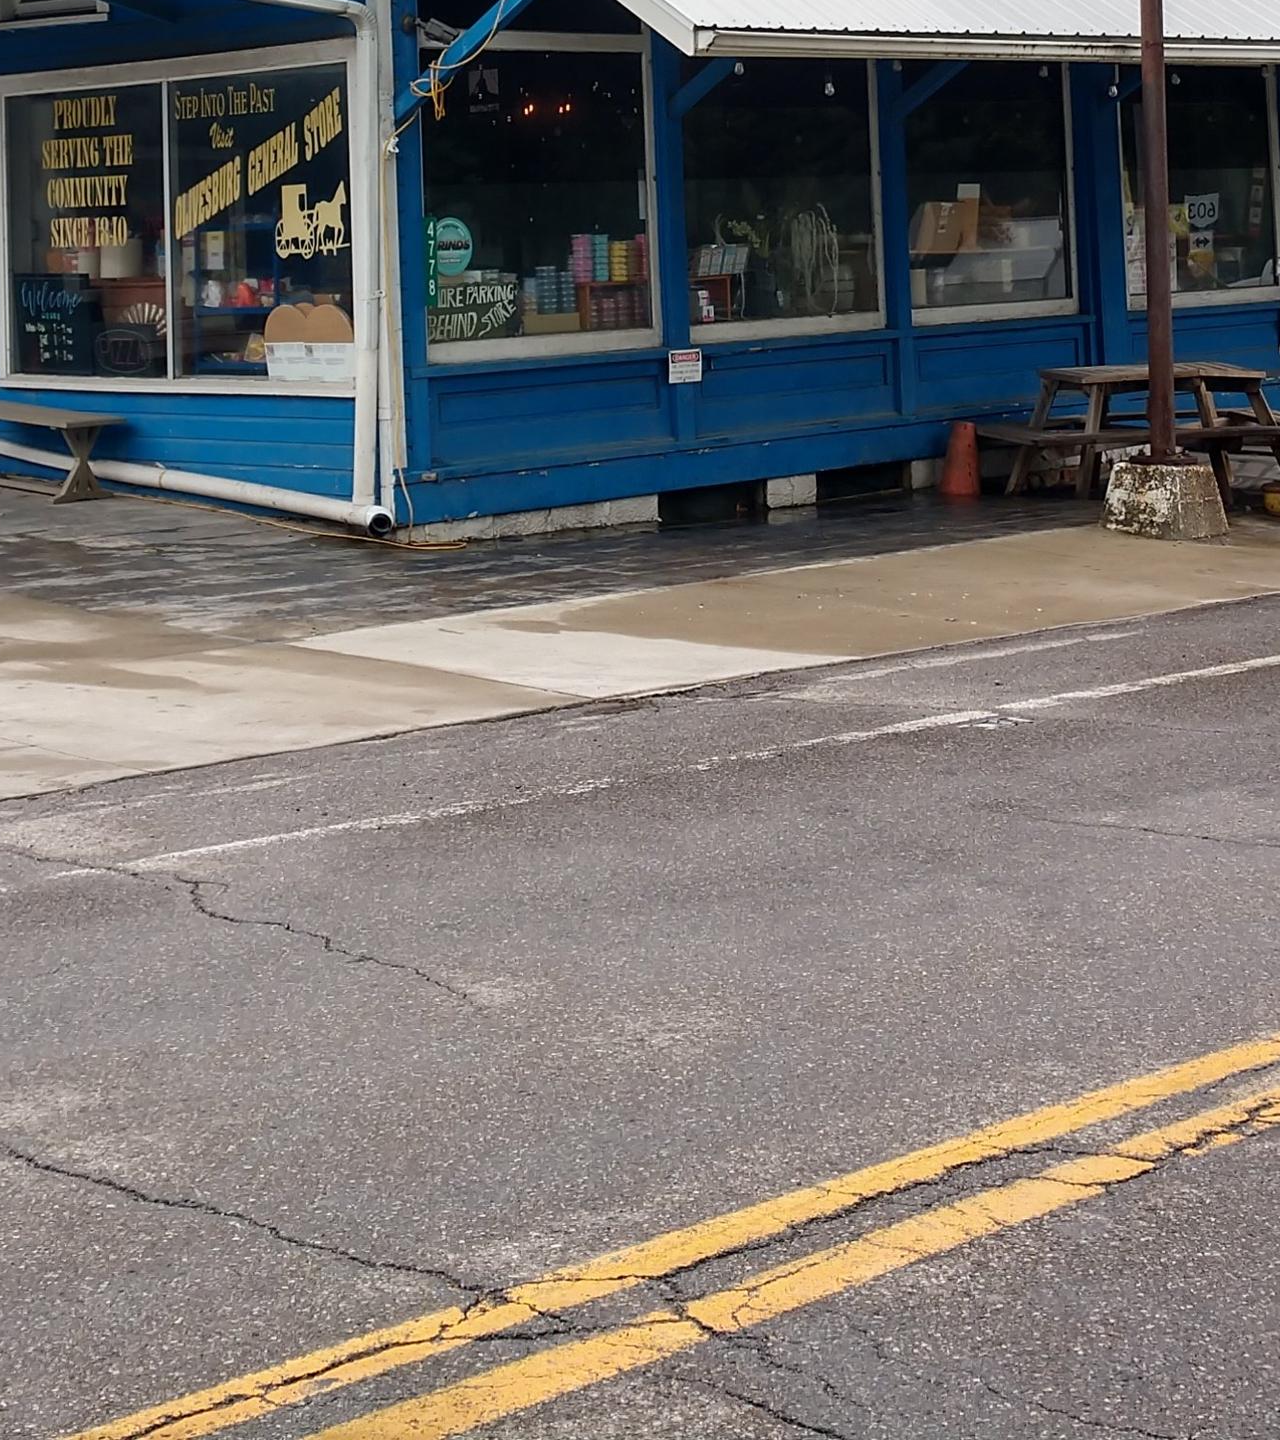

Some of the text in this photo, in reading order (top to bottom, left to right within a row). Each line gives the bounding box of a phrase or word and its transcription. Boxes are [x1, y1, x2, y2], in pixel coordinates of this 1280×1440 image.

[53, 95, 117, 129] PROUDLY
[41, 134, 133, 169] SERVING THE
[209, 122, 234, 149] Visit
[175, 86, 342, 240] OLIVESBURG GENERAL STORE
[47, 175, 128, 208] COMMUNITY
[50, 216, 128, 248] SINCE 1840
[437, 240, 471, 251] RINDS
[427, 221, 436, 296] 4778
[437, 284, 514, 308] ORE PARKING
[428, 299, 517, 340] BEHIND STORE
